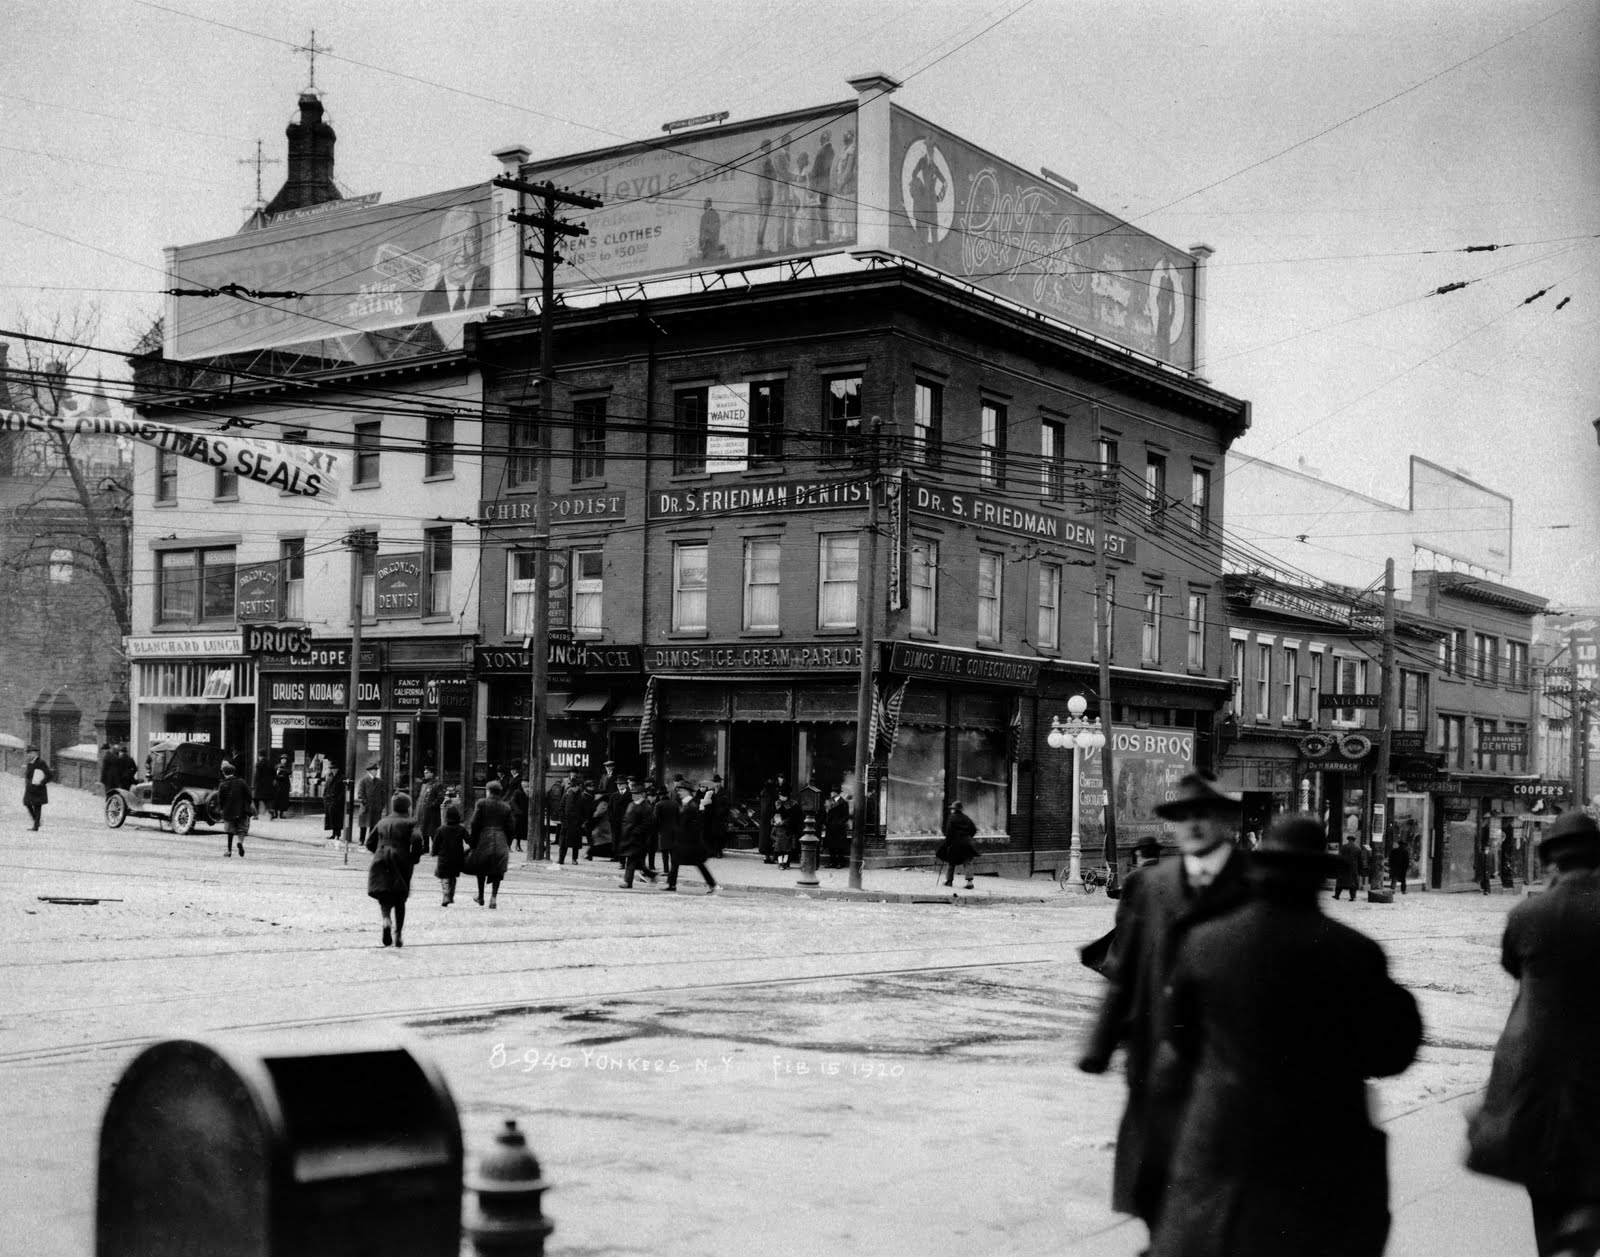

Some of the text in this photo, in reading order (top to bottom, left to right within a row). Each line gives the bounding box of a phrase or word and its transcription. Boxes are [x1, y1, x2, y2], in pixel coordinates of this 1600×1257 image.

[604, 225, 662, 246] CLOTHES
[710, 409, 746, 421] WANTED
[0, 410, 66, 434] OSS
[235, 449, 322, 498] SEALS
[704, 486, 787, 510] FRIEDMAN
[485, 497, 621, 519] CHIRPODIST
[974, 500, 1057, 537] FRIEDMAN
[1066, 521, 1128, 558] DENIST
[240, 599, 275, 614] DENTIST
[379, 593, 419, 609] DENTIST
[133, 639, 241, 653] BLANCHARD LUNCH
[249, 629, 311, 653] DRUGS
[311, 651, 345, 665] POPE
[710, 649, 735, 667] ICE
[743, 648, 791, 666] CREAM
[802, 647, 863, 666] PARLOR
[941, 655, 962, 675] FINE
[967, 658, 1033, 685] CONFECTIONERY
[398, 679, 421, 687] FANCY
[272, 683, 305, 701] DRUGS
[357, 683, 381, 701] ODA
[393, 688, 425, 696] CALIFORNIA
[398, 697, 420, 705] FRUITS
[1322, 697, 1376, 706] TAILOR
[308, 718, 342, 728] CIGARS
[189, 732, 211, 743] LUNCH
[552, 739, 588, 749] YONKERS
[1145, 735, 1191, 761] BROS
[1482, 742, 1522, 751] DENTIST
[550, 753, 590, 768] LUNCH
[1513, 785, 1564, 796] COOPER'S
